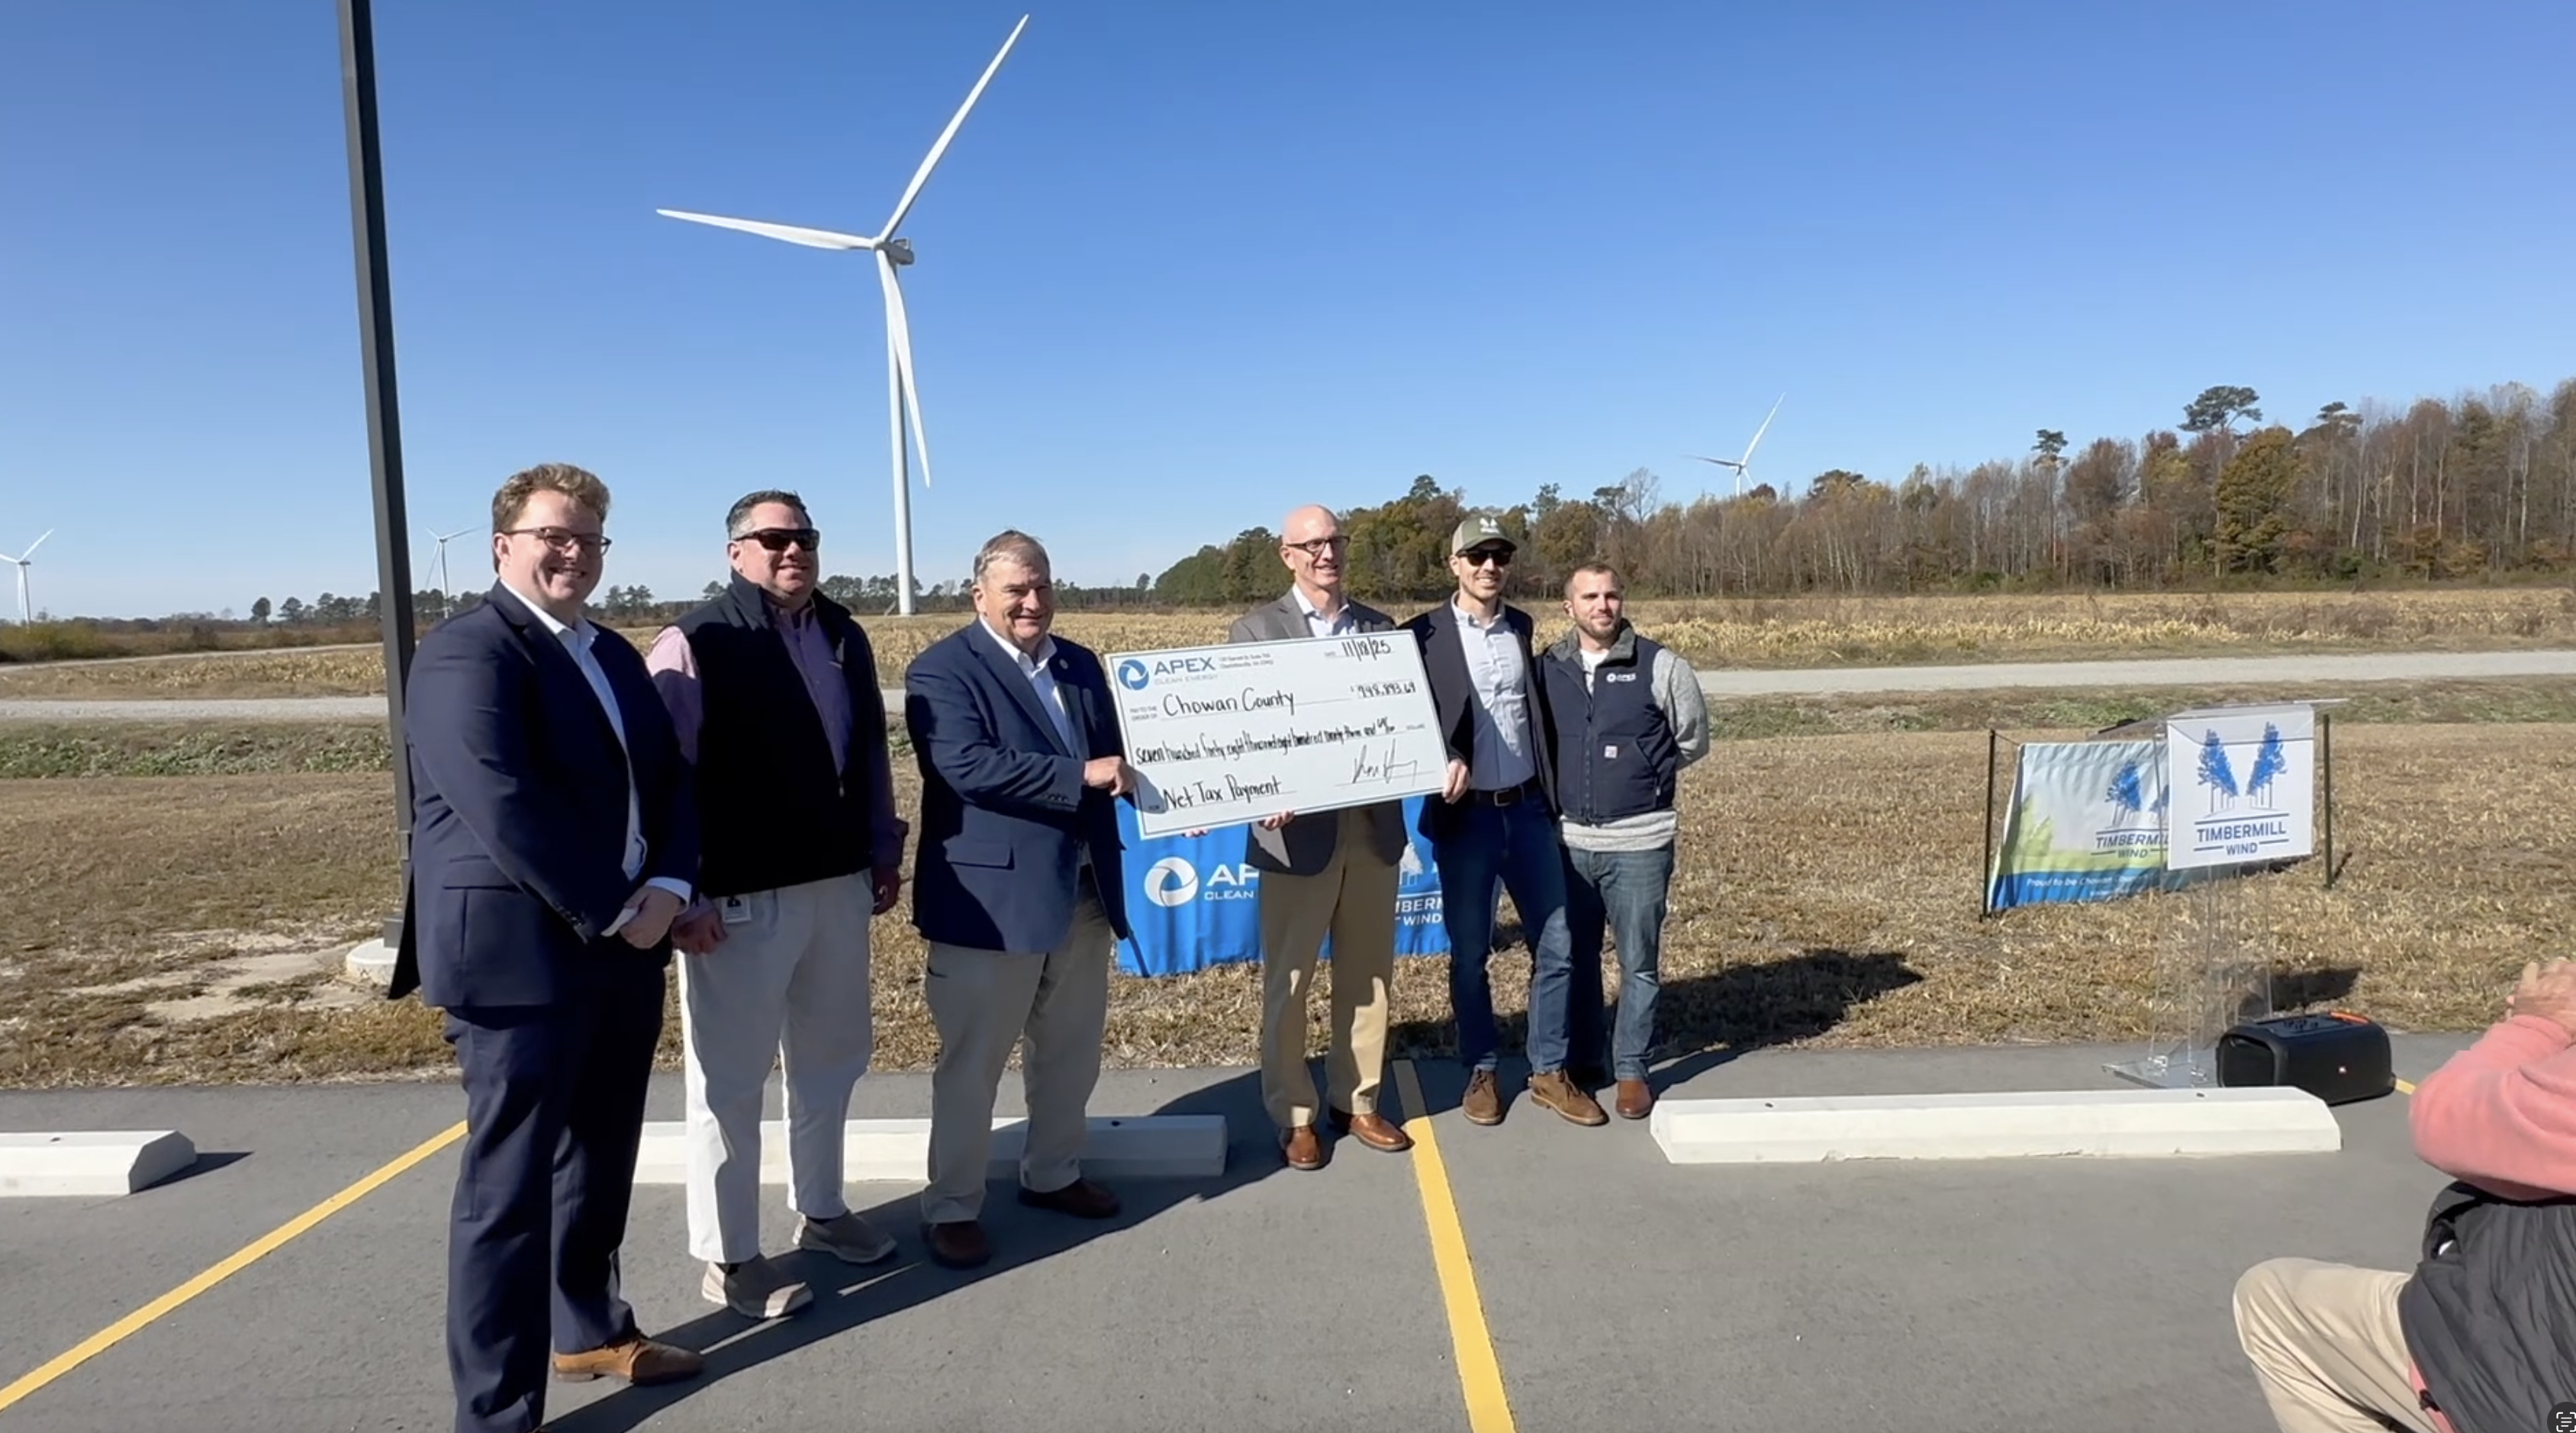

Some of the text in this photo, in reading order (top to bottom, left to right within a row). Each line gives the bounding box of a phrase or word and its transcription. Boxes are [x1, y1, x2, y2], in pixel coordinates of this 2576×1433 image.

[1341, 636, 1391, 662] 11/18/25
[1154, 657, 1216, 675] APEX
[1163, 687, 1295, 717] Chowan County
[1163, 774, 1281, 809] Net Tax Payment
[2197, 821, 2287, 842] TIMBERMILL
[2118, 848, 2149, 858] WIND
[2227, 842, 2258, 855] WIND
[1206, 864, 1259, 886] AP
[1205, 890, 1254, 900] CLEAN
[1403, 913, 1442, 926] WIND
